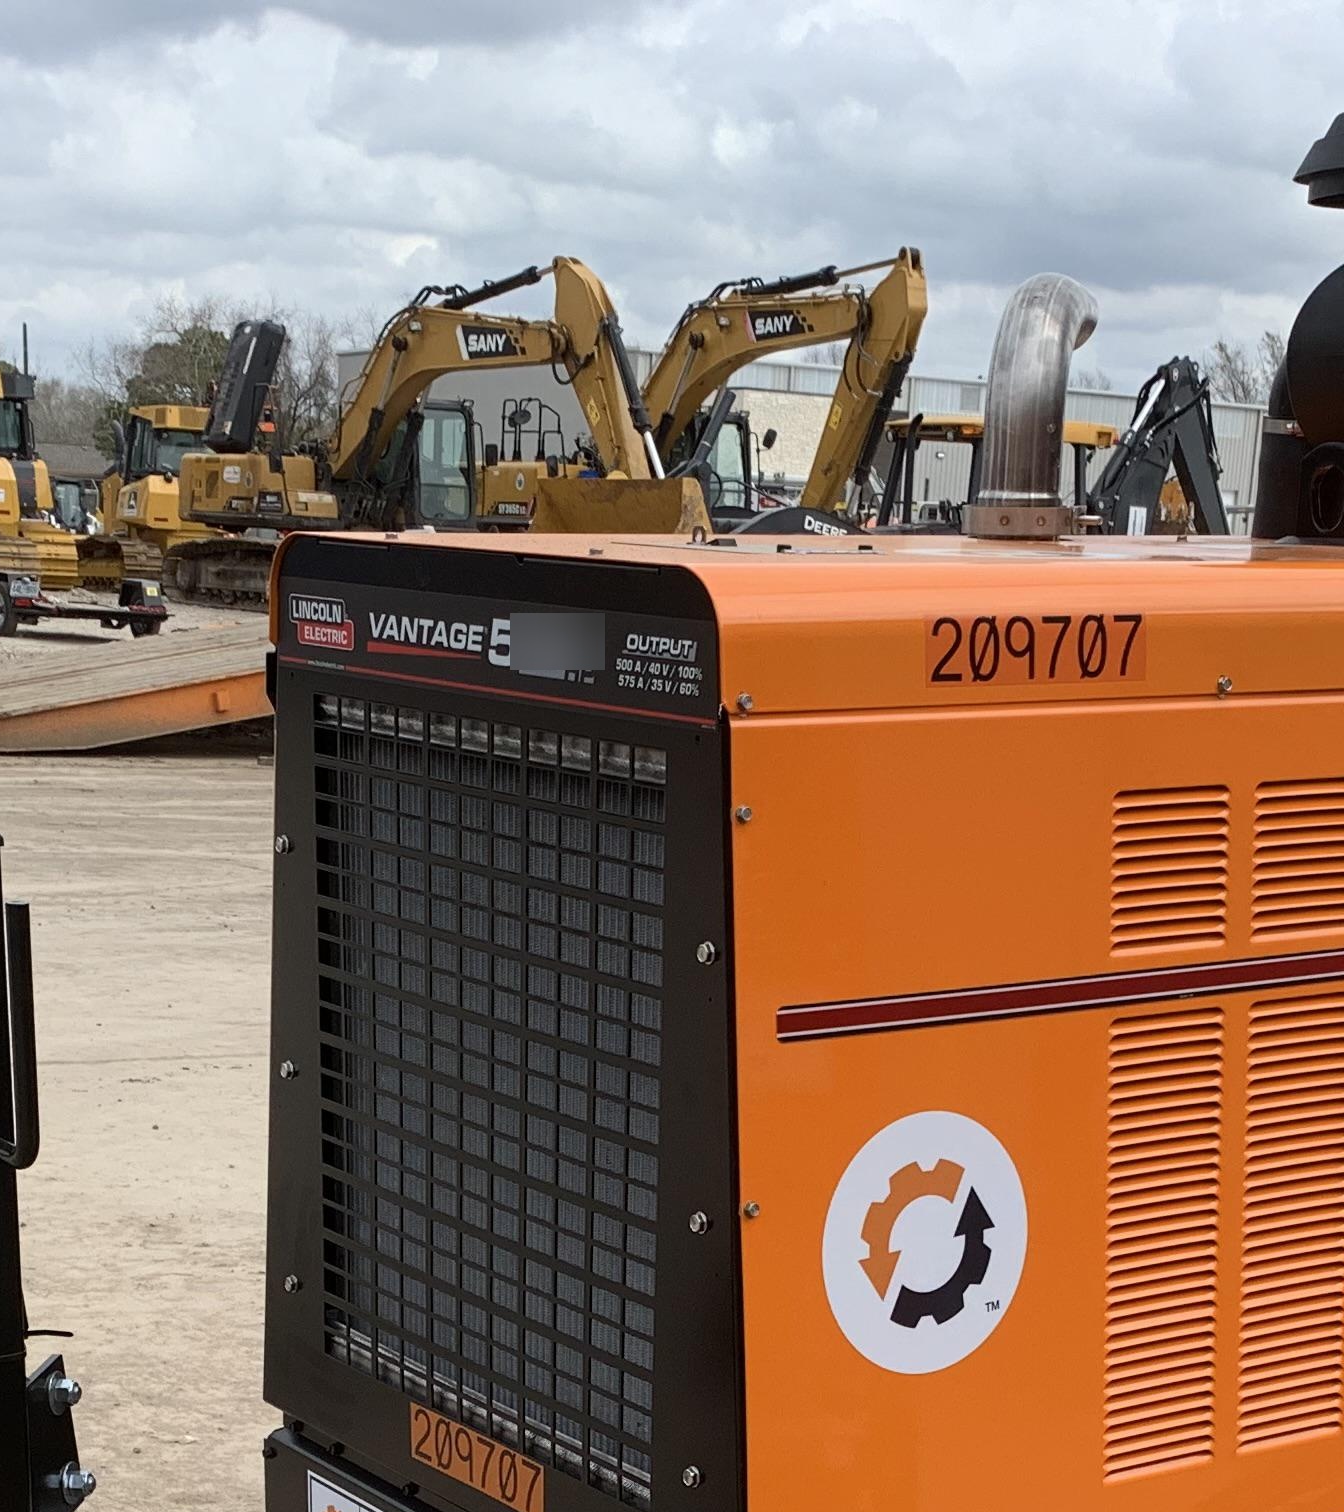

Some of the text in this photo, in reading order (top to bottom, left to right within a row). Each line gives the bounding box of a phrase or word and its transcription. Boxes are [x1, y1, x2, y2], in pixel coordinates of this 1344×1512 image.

[753, 314, 794, 335] SANY
[467, 333, 507, 353] SANY
[291, 598, 343, 624] LINCOLN
[303, 625, 348, 645] ELECTRIC
[368, 611, 484, 652] VANTAGE
[625, 632, 693, 656] OUTPUT
[930, 613, 1142, 682] 209707
[615, 657, 633, 671] 500
[634, 660, 642, 673] A
[648, 662, 661, 675] 40
[662, 663, 670, 676] V
[677, 665, 703, 681] 100%
[617, 674, 636, 688] 575
[636, 676, 644, 689] A
[650, 679, 663, 691] 35
[664, 680, 672, 693] V
[679, 682, 700, 697] 60%
[984, 1299, 1001, 1313] TM
[413, 1408, 542, 1512] 209707
